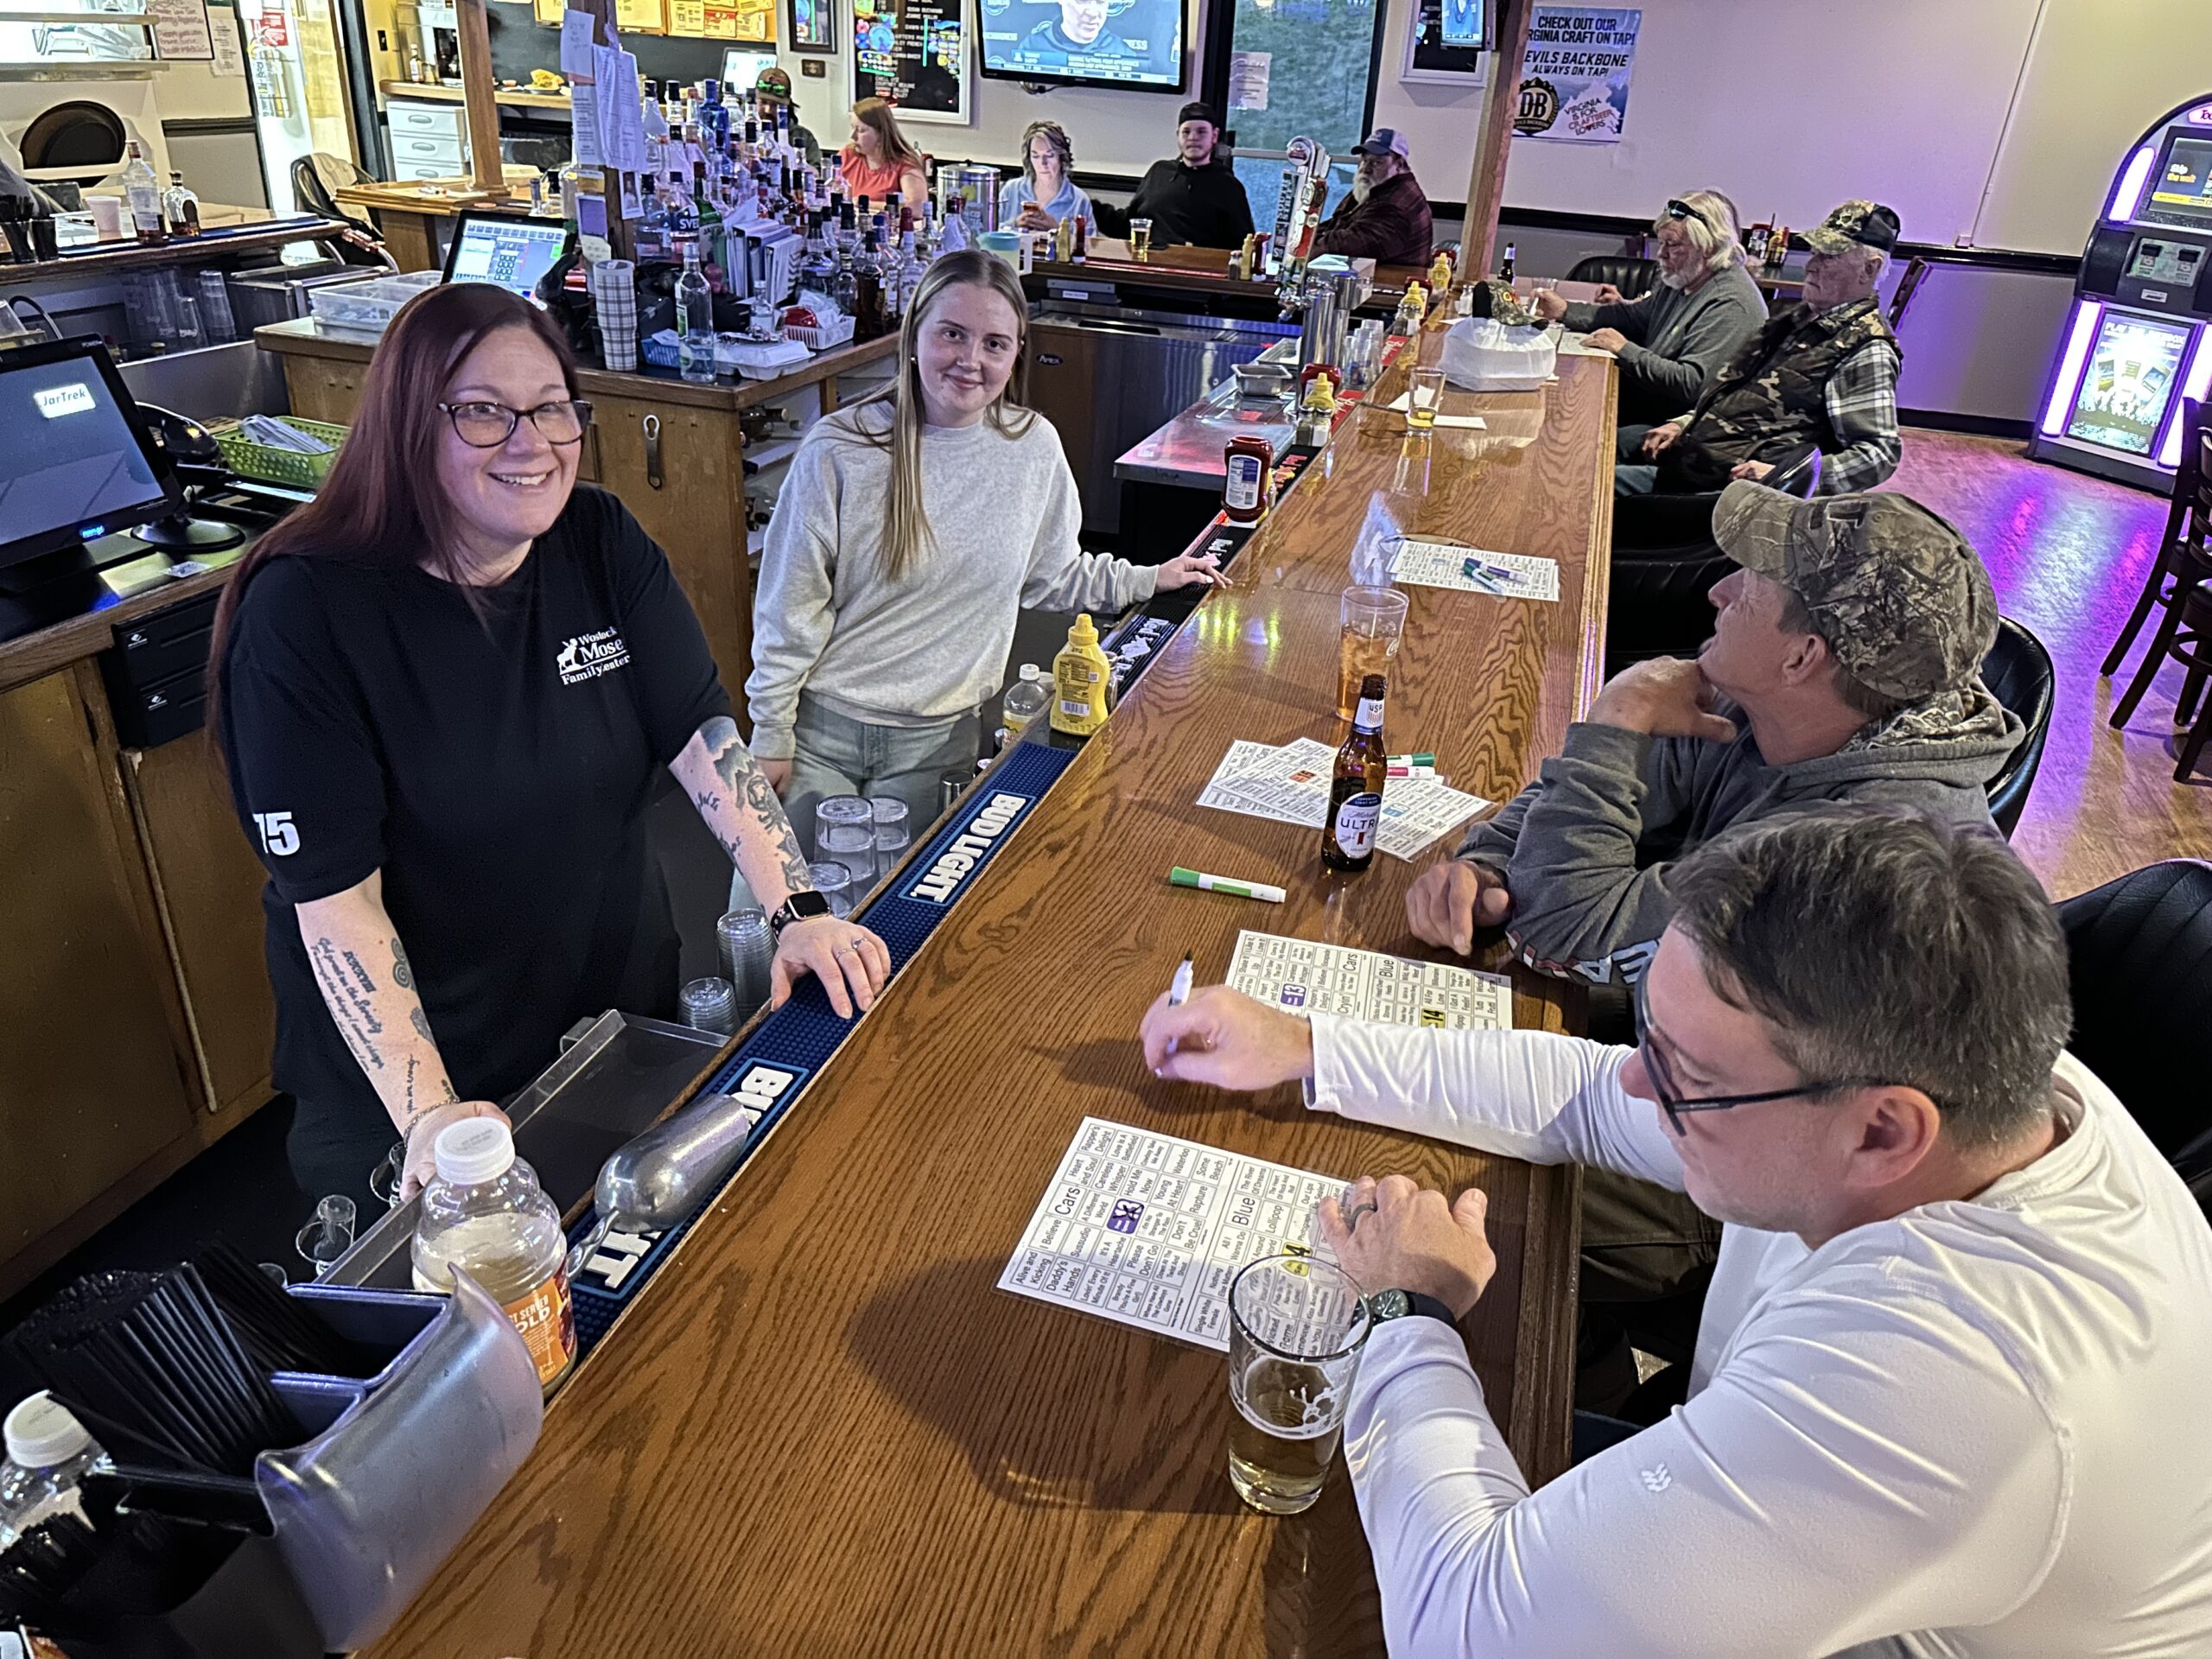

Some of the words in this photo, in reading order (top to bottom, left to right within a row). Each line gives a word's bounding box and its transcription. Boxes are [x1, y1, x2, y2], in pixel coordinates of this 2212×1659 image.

[1538, 16, 1570, 29] CHECK
[1573, 17, 1593, 30] OUT
[1595, 18, 1617, 31] OUR
[1527, 29, 1559, 41] RGINIA
[1562, 30, 1595, 43] CRAFT
[1596, 31, 1610, 43] ON
[1613, 33, 1635, 45] TAP!
[1524, 50, 1559, 63] EVILS
[1561, 52, 1629, 67] BACKBONE
[1531, 65, 1569, 74] ALWAYS
[1571, 67, 1584, 75] ON
[1587, 67, 1609, 77] TAP!
[1520, 92, 1548, 118] DB
[1564, 98, 1602, 115] VIRGINIA
[1581, 107, 1597, 118] FOR
[43, 388, 86, 406] JarTrek
[561, 664, 602, 685] Family
[970, 794, 1027, 837] BUD
[913, 835, 992, 903] LIGHT
[1287, 964, 1298, 982] Careless
[1343, 954, 1357, 971] Cars
[1379, 959, 1395, 977] Blue
[1259, 983, 1268, 995] Heart
[1284, 985, 1306, 996] 13
[1436, 994, 1445, 1005] Love
[1319, 993, 1330, 1008] Delight
[1423, 1009, 1443, 1021] 14
[1081, 1126, 1100, 1151] Rapper's
[1095, 1131, 1112, 1153] Delight
[1122, 1135, 1139, 1161] Battlefield
[1069, 1159, 1084, 1177] Heart
[1081, 1171, 1090, 1185] and
[1088, 1157, 1098, 1172] Soul
[1173, 1148, 1190, 1174] Waterloo
[1196, 1157, 1211, 1176] Some
[1210, 1160, 1224, 1180] Beach
[1095, 1162, 1115, 1189] Careless
[1108, 1166, 1127, 1192] Whisper
[1123, 1180, 1138, 1196] Hold
[1132, 1169, 1142, 1180] Me
[1246, 1166, 1255, 1179] River
[1255, 1168, 1267, 1186] Dreams
[1140, 1179, 1154, 1194] Now
[1154, 1179, 1173, 1200] Young
[1171, 1179, 1185, 1199] Heart
[1054, 1187, 1080, 1215] Cars
[1084, 1193, 1101, 1217] Different
[1095, 1201, 1109, 1218] World
[1167, 1198, 1176, 1208] At
[1189, 1185, 1208, 1213] Rapture
[1301, 1193, 1310, 1205] Our
[1232, 1198, 1255, 1226] Blue
[1265, 1205, 1284, 1234] Lollipop
[1042, 1219, 1061, 1245] Believe
[1172, 1220, 1187, 1240] Don't
[1188, 1218, 1203, 1237] Cruel
[1298, 1213, 1311, 1241] Photograph
[1071, 1228, 1091, 1257] Sussudio
[1099, 1247, 1108, 1256] It's
[1108, 1237, 1127, 1267] Heartache
[1185, 1239, 1195, 1249] Be
[1230, 1240, 1243, 1260] Wanna
[1240, 1231, 1246, 1240] Do
[1253, 1236, 1266, 1257] Around
[1127, 1245, 1144, 1268] Please
[1139, 1256, 1153, 1275] Don't
[1147, 1245, 1159, 1256] Go
[1015, 1266, 1030, 1284] Alive
[1027, 1252, 1038, 1266] and
[1030, 1258, 1052, 1284] Kicking
[1046, 1261, 1068, 1291] Daddy's
[1177, 1262, 1187, 1276] Shout
[1210, 1268, 1224, 1289] Nothing
[1062, 1268, 1081, 1292] Hands
[1081, 1284, 1092, 1301] Lovin'
[1088, 1268, 1102, 1284] Every
[1217, 1285, 1226, 1296] Else
[1222, 1266, 1234, 1284] Matters
[1195, 1316, 1206, 1333] Single
[1201, 1300, 1211, 1315] White
[1207, 1308, 1220, 1329] Female
